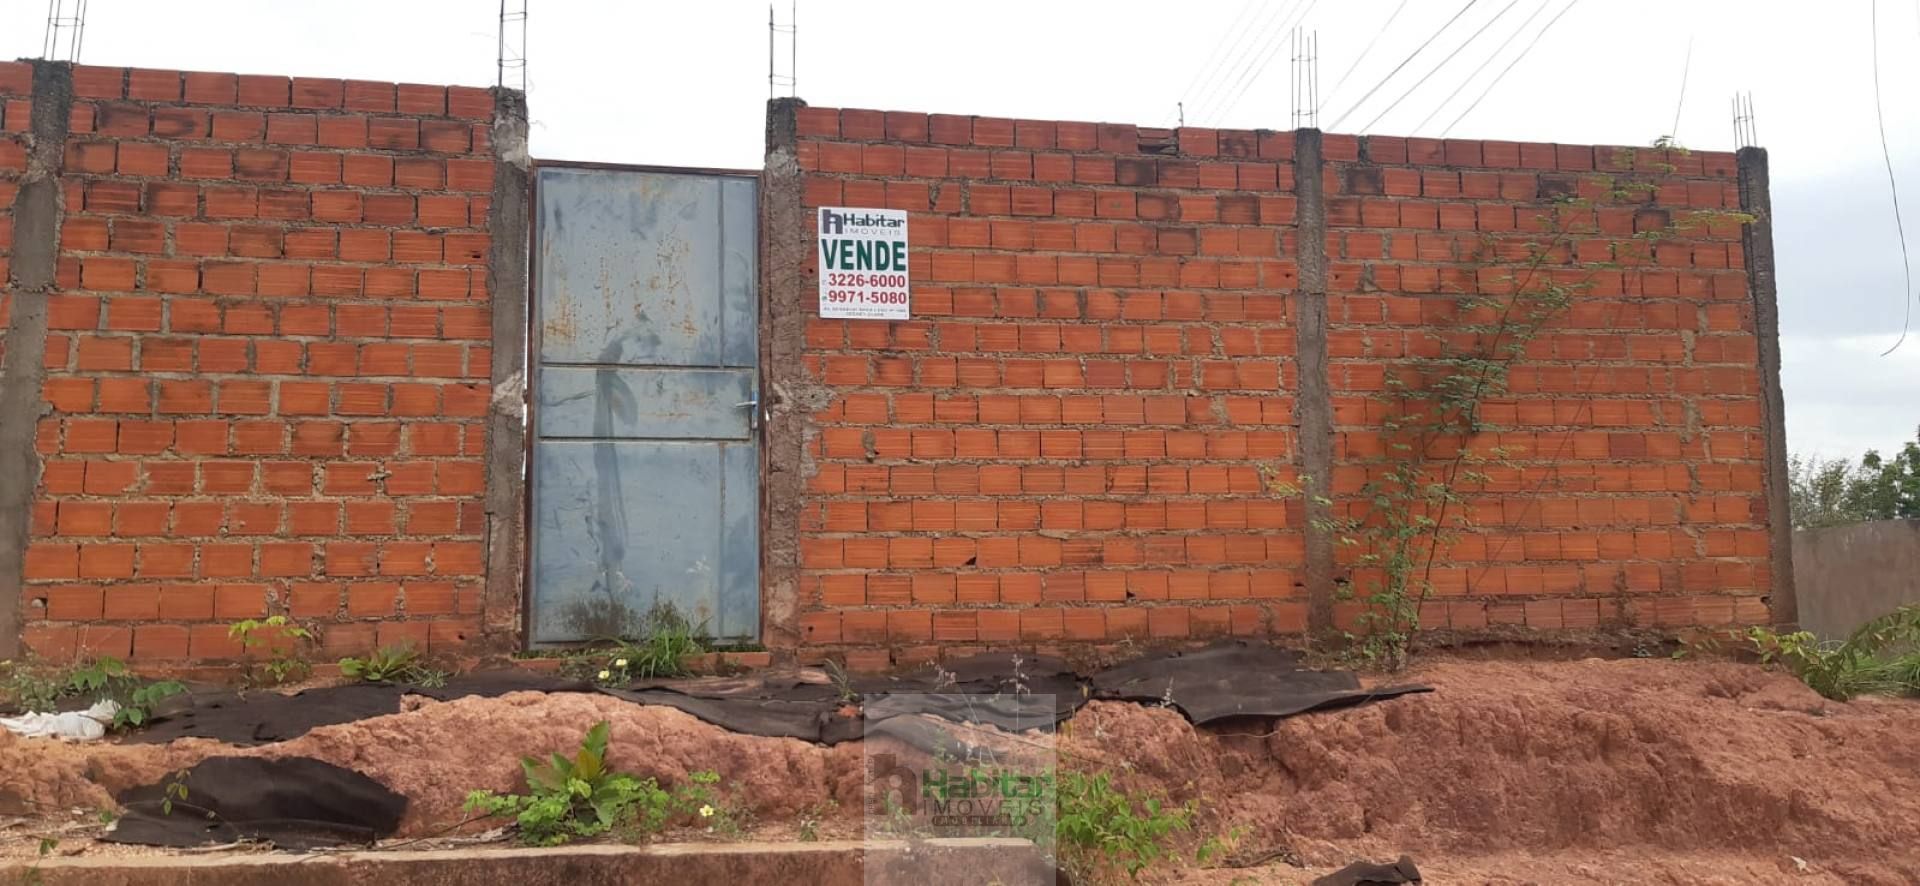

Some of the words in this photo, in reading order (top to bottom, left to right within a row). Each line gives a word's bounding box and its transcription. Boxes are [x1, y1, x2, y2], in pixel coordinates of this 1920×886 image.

[843, 213, 905, 228] Habitar
[821, 239, 907, 271] VENDE
[828, 273, 905, 287] 3226-6000
[828, 290, 907, 304] 9971-5080
